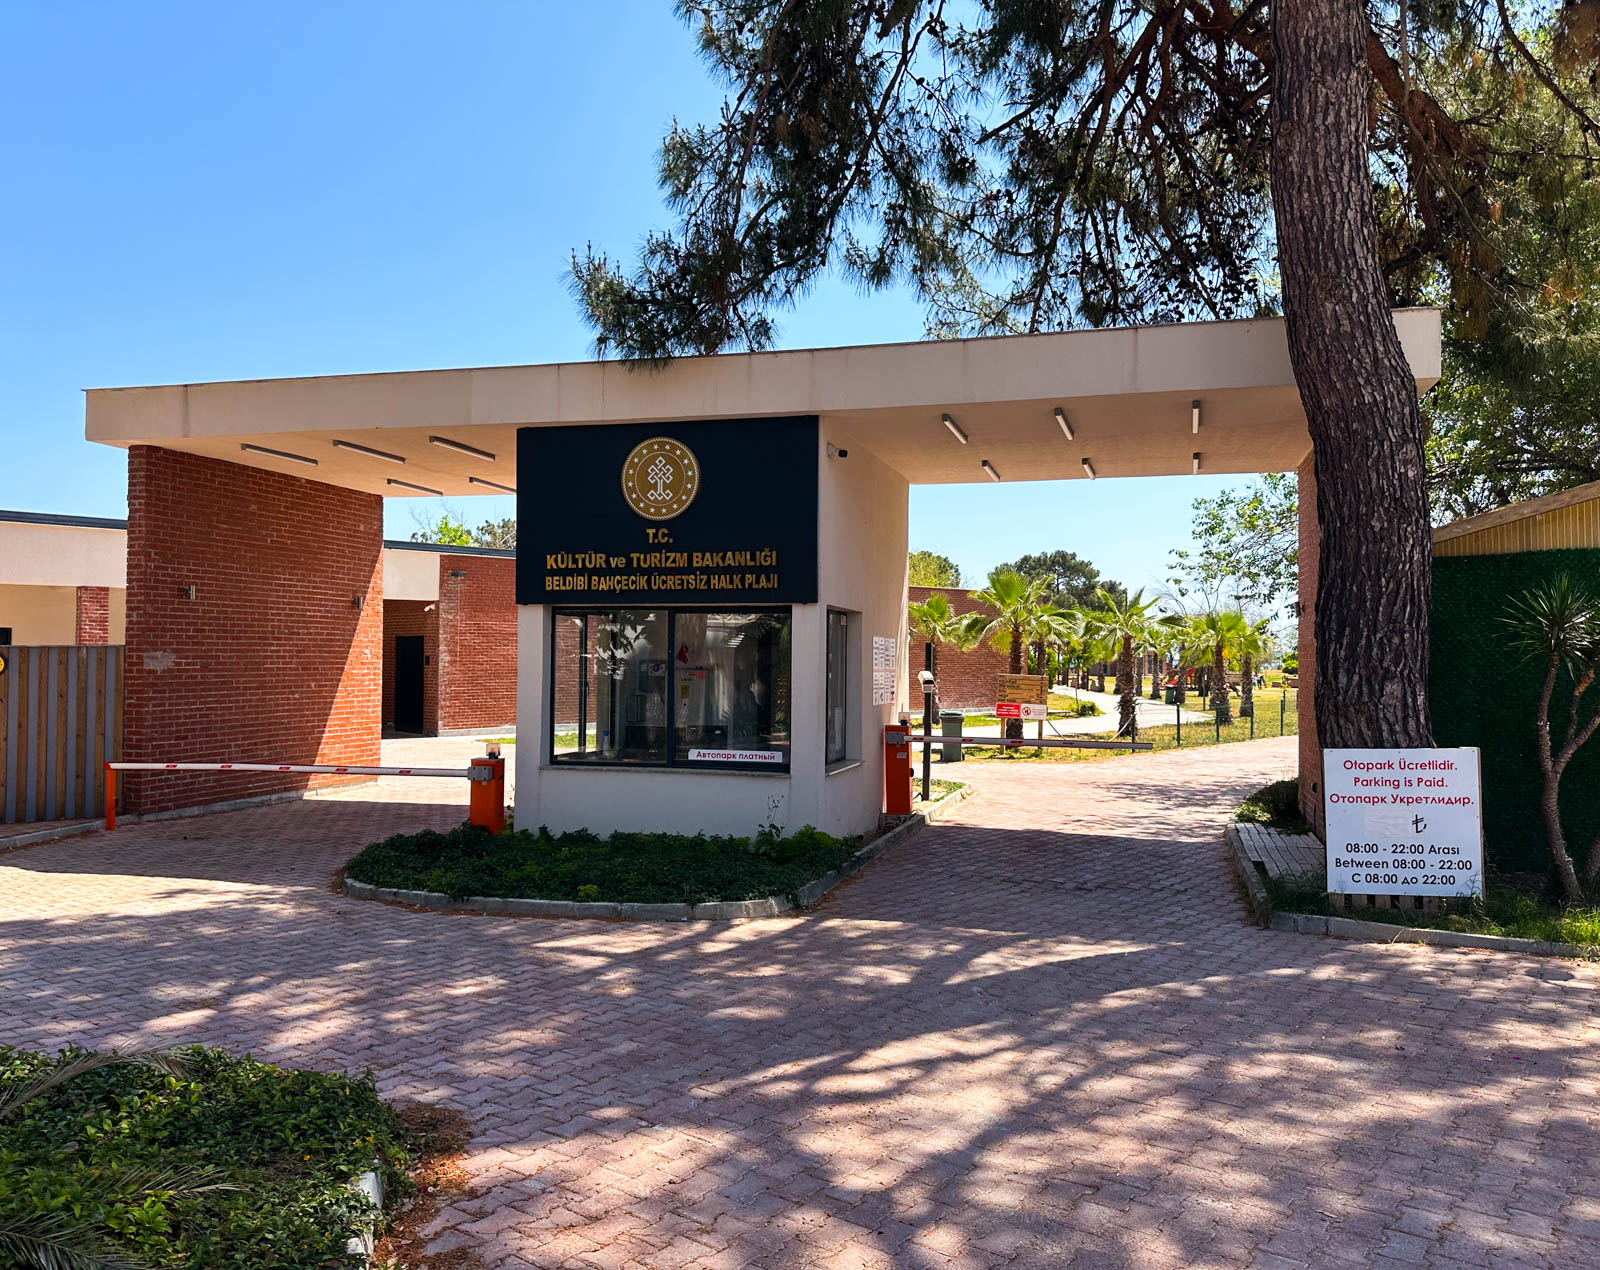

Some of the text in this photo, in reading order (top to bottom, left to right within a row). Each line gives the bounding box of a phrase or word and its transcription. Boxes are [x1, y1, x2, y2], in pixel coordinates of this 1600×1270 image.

[646, 528, 673, 544] T.C.
[546, 548, 777, 569] KÜLTÜR ve TURİZM BAKANLIĞI
[545, 571, 778, 593] BELDİBİ BAHÇECİK ÜCRETSİZ HALK PLAJI
[696, 751, 775, 761] Автопарк платный
[1343, 758, 1458, 772] Otopark Ücretlidir.
[1354, 777, 1448, 789] Parking is Paid.
[1329, 793, 1474, 807] Отопарк Укретлидир.
[1346, 843, 1379, 854] 08:00
[1391, 843, 1424, 855] 22:00
[1428, 844, 1460, 856] Arası
[1335, 858, 1389, 869] Between
[1392, 859, 1426, 870] 08:00
[1438, 859, 1472, 871] 22:00
[1365, 873, 1398, 884] 08:00
[1401, 875, 1418, 885] до
[1422, 874, 1456, 886] 22:00
